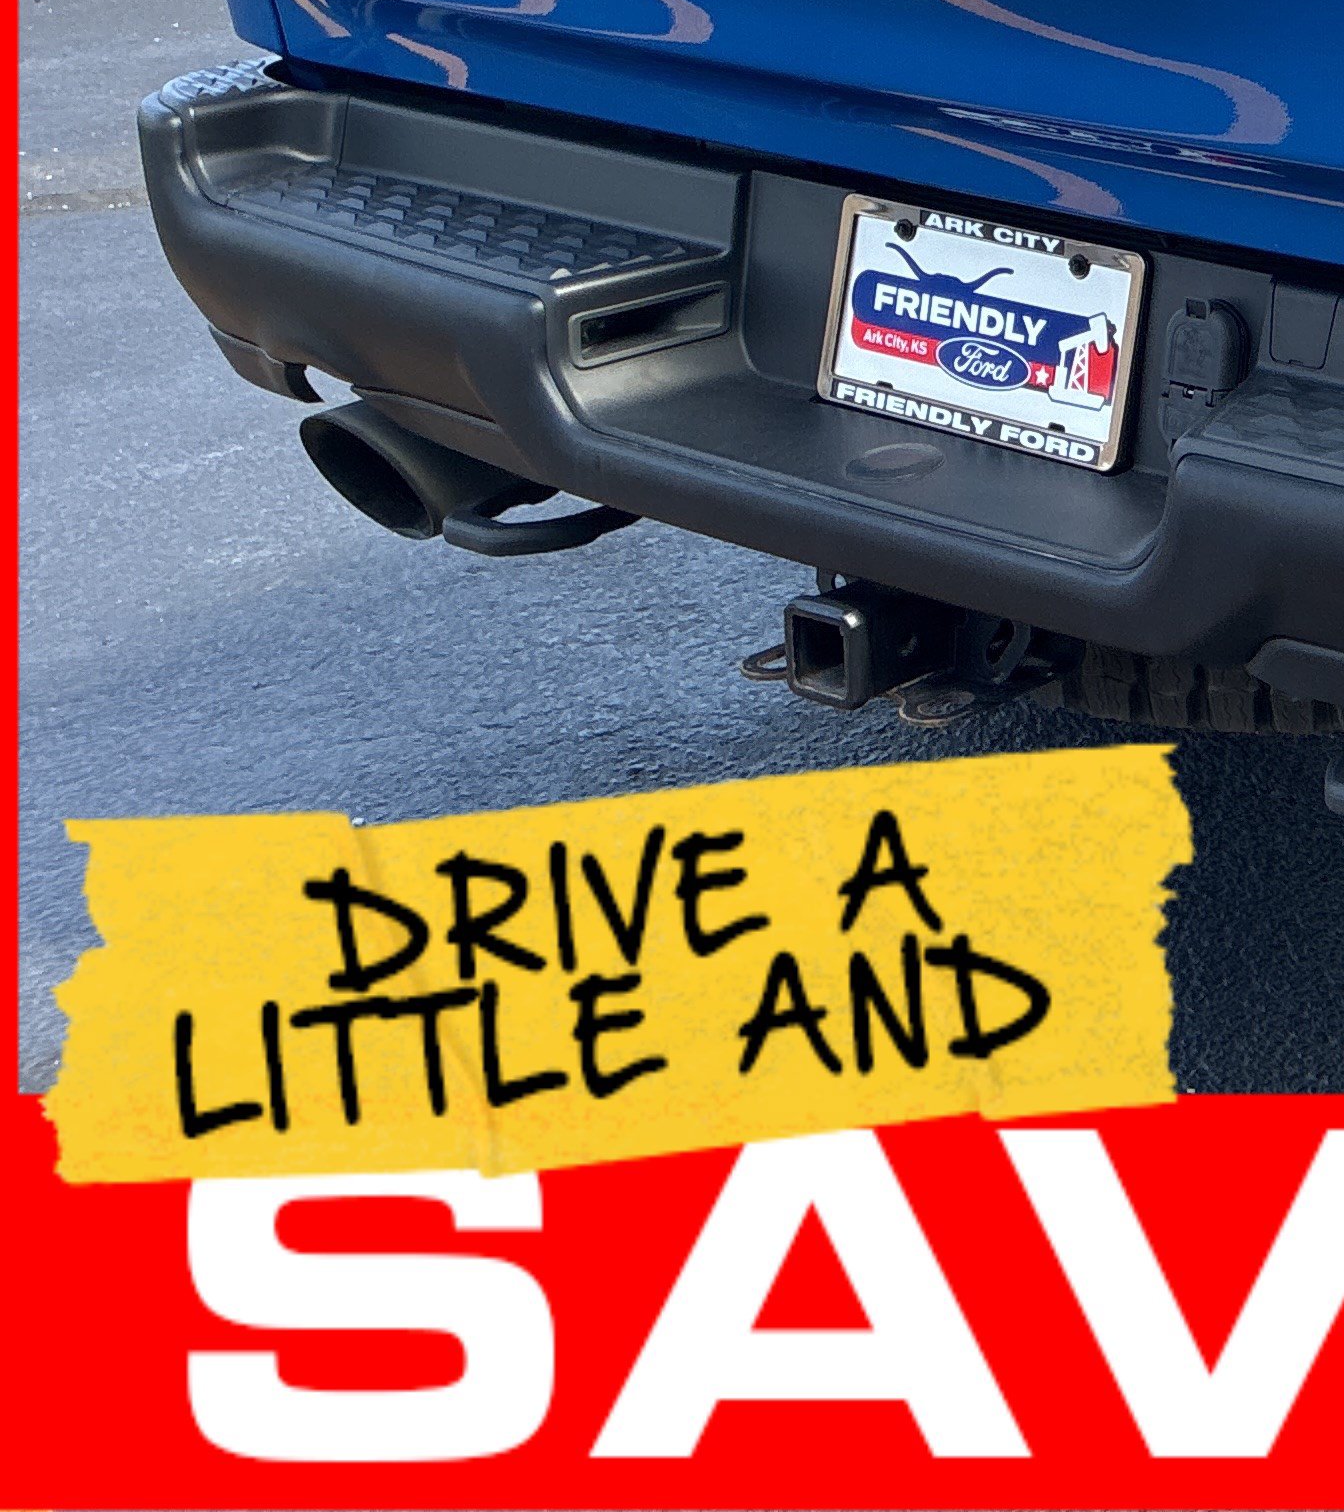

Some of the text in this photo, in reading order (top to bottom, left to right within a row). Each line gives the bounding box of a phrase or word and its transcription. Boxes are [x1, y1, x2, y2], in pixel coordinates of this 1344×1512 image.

[924, 212, 1062, 253] ARK CITY
[873, 282, 1048, 346] FRIENDLY
[862, 328, 928, 355] Ark City, KS
[954, 341, 1012, 383] Ford
[836, 382, 1096, 462] FRIENDLY FORD
